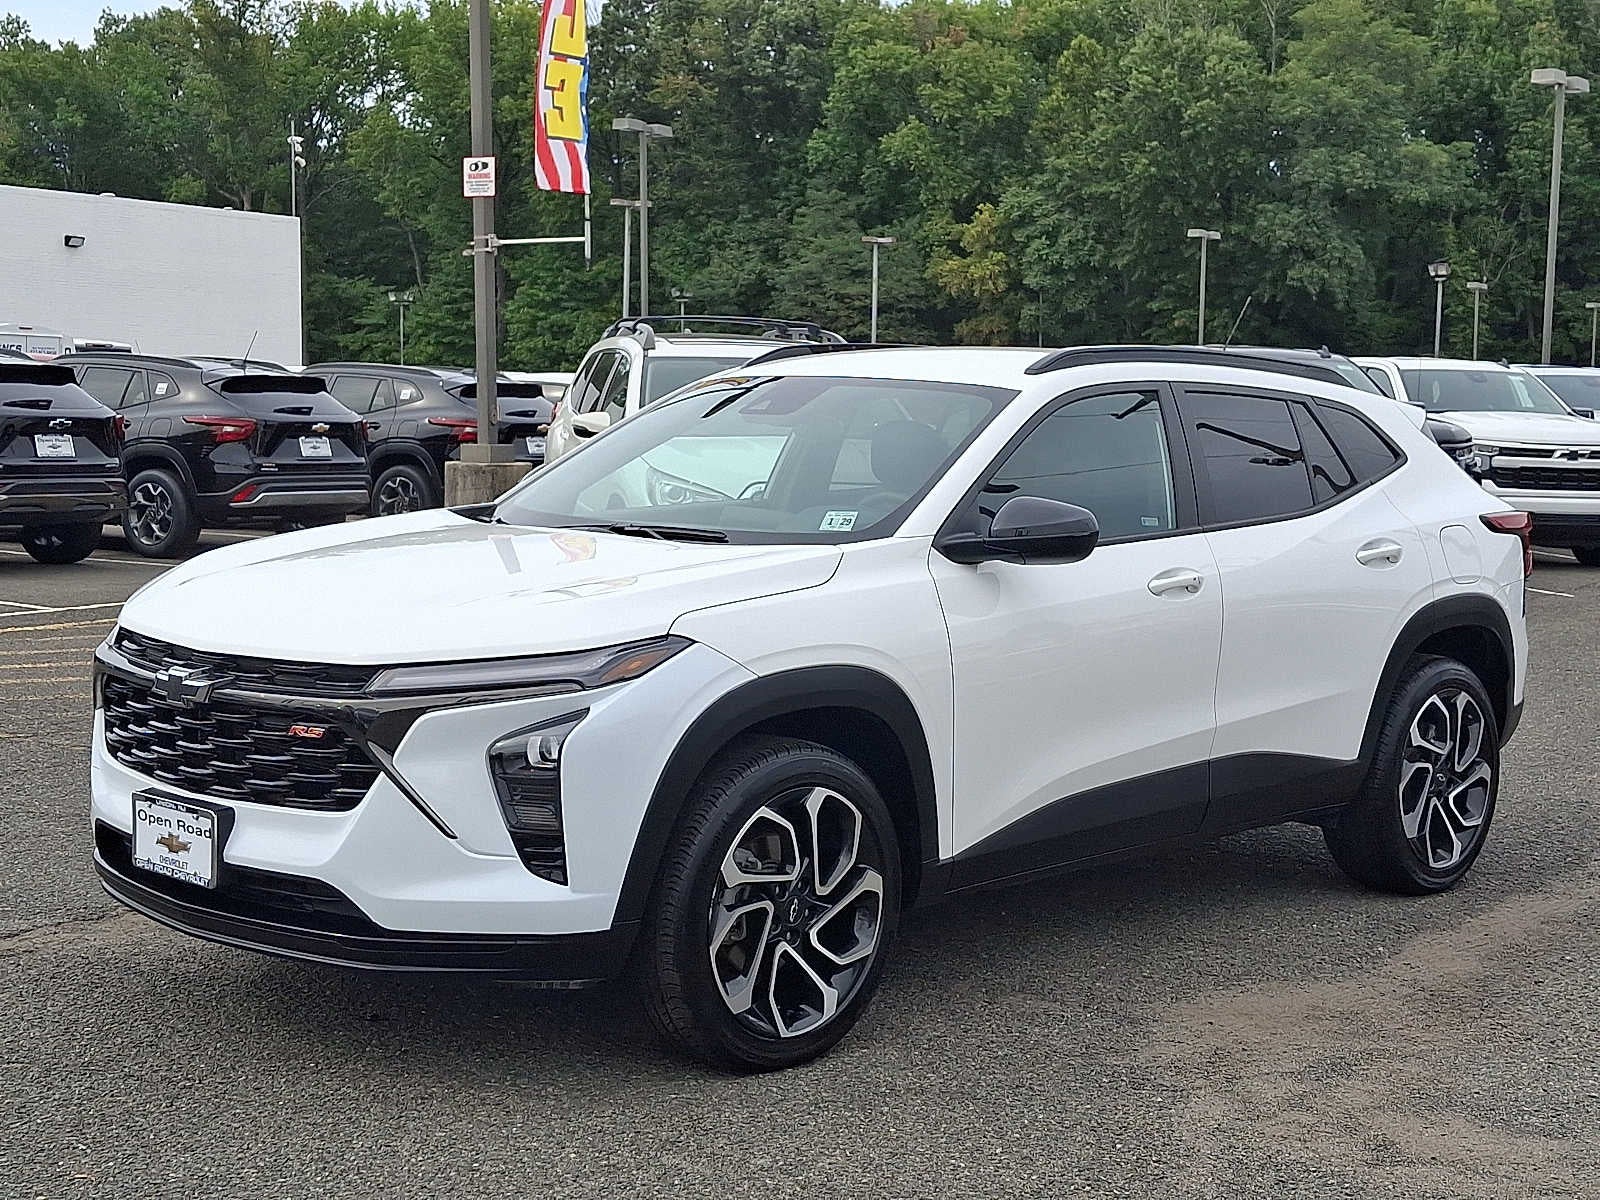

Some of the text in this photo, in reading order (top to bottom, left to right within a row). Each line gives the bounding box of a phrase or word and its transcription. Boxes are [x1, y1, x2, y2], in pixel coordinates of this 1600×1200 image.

[840, 517, 852, 526] 29
[289, 725, 325, 738] RS
[137, 808, 212, 839] Open Road
[135, 858, 210, 887] OPEN ROAD CHEVROLET
